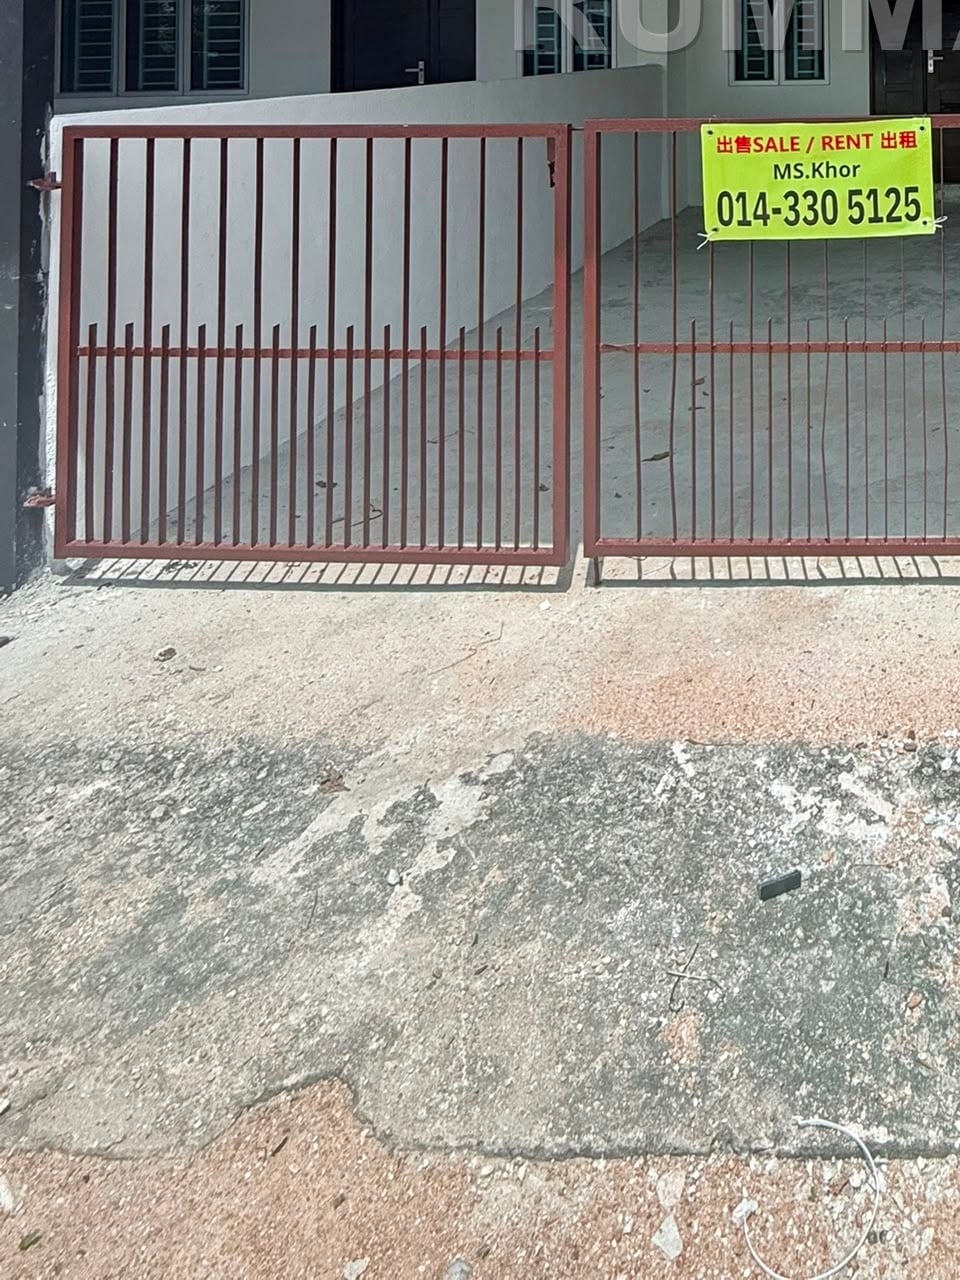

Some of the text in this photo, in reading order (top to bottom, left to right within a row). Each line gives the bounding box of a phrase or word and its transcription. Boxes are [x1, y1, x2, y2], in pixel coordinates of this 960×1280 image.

[806, 136, 815, 154] /
[821, 133, 874, 151] RENT
[880, 131, 918, 149] 出租
[773, 161, 861, 180] MS.Khor
[717, 186, 921, 227] 014-330 5125
